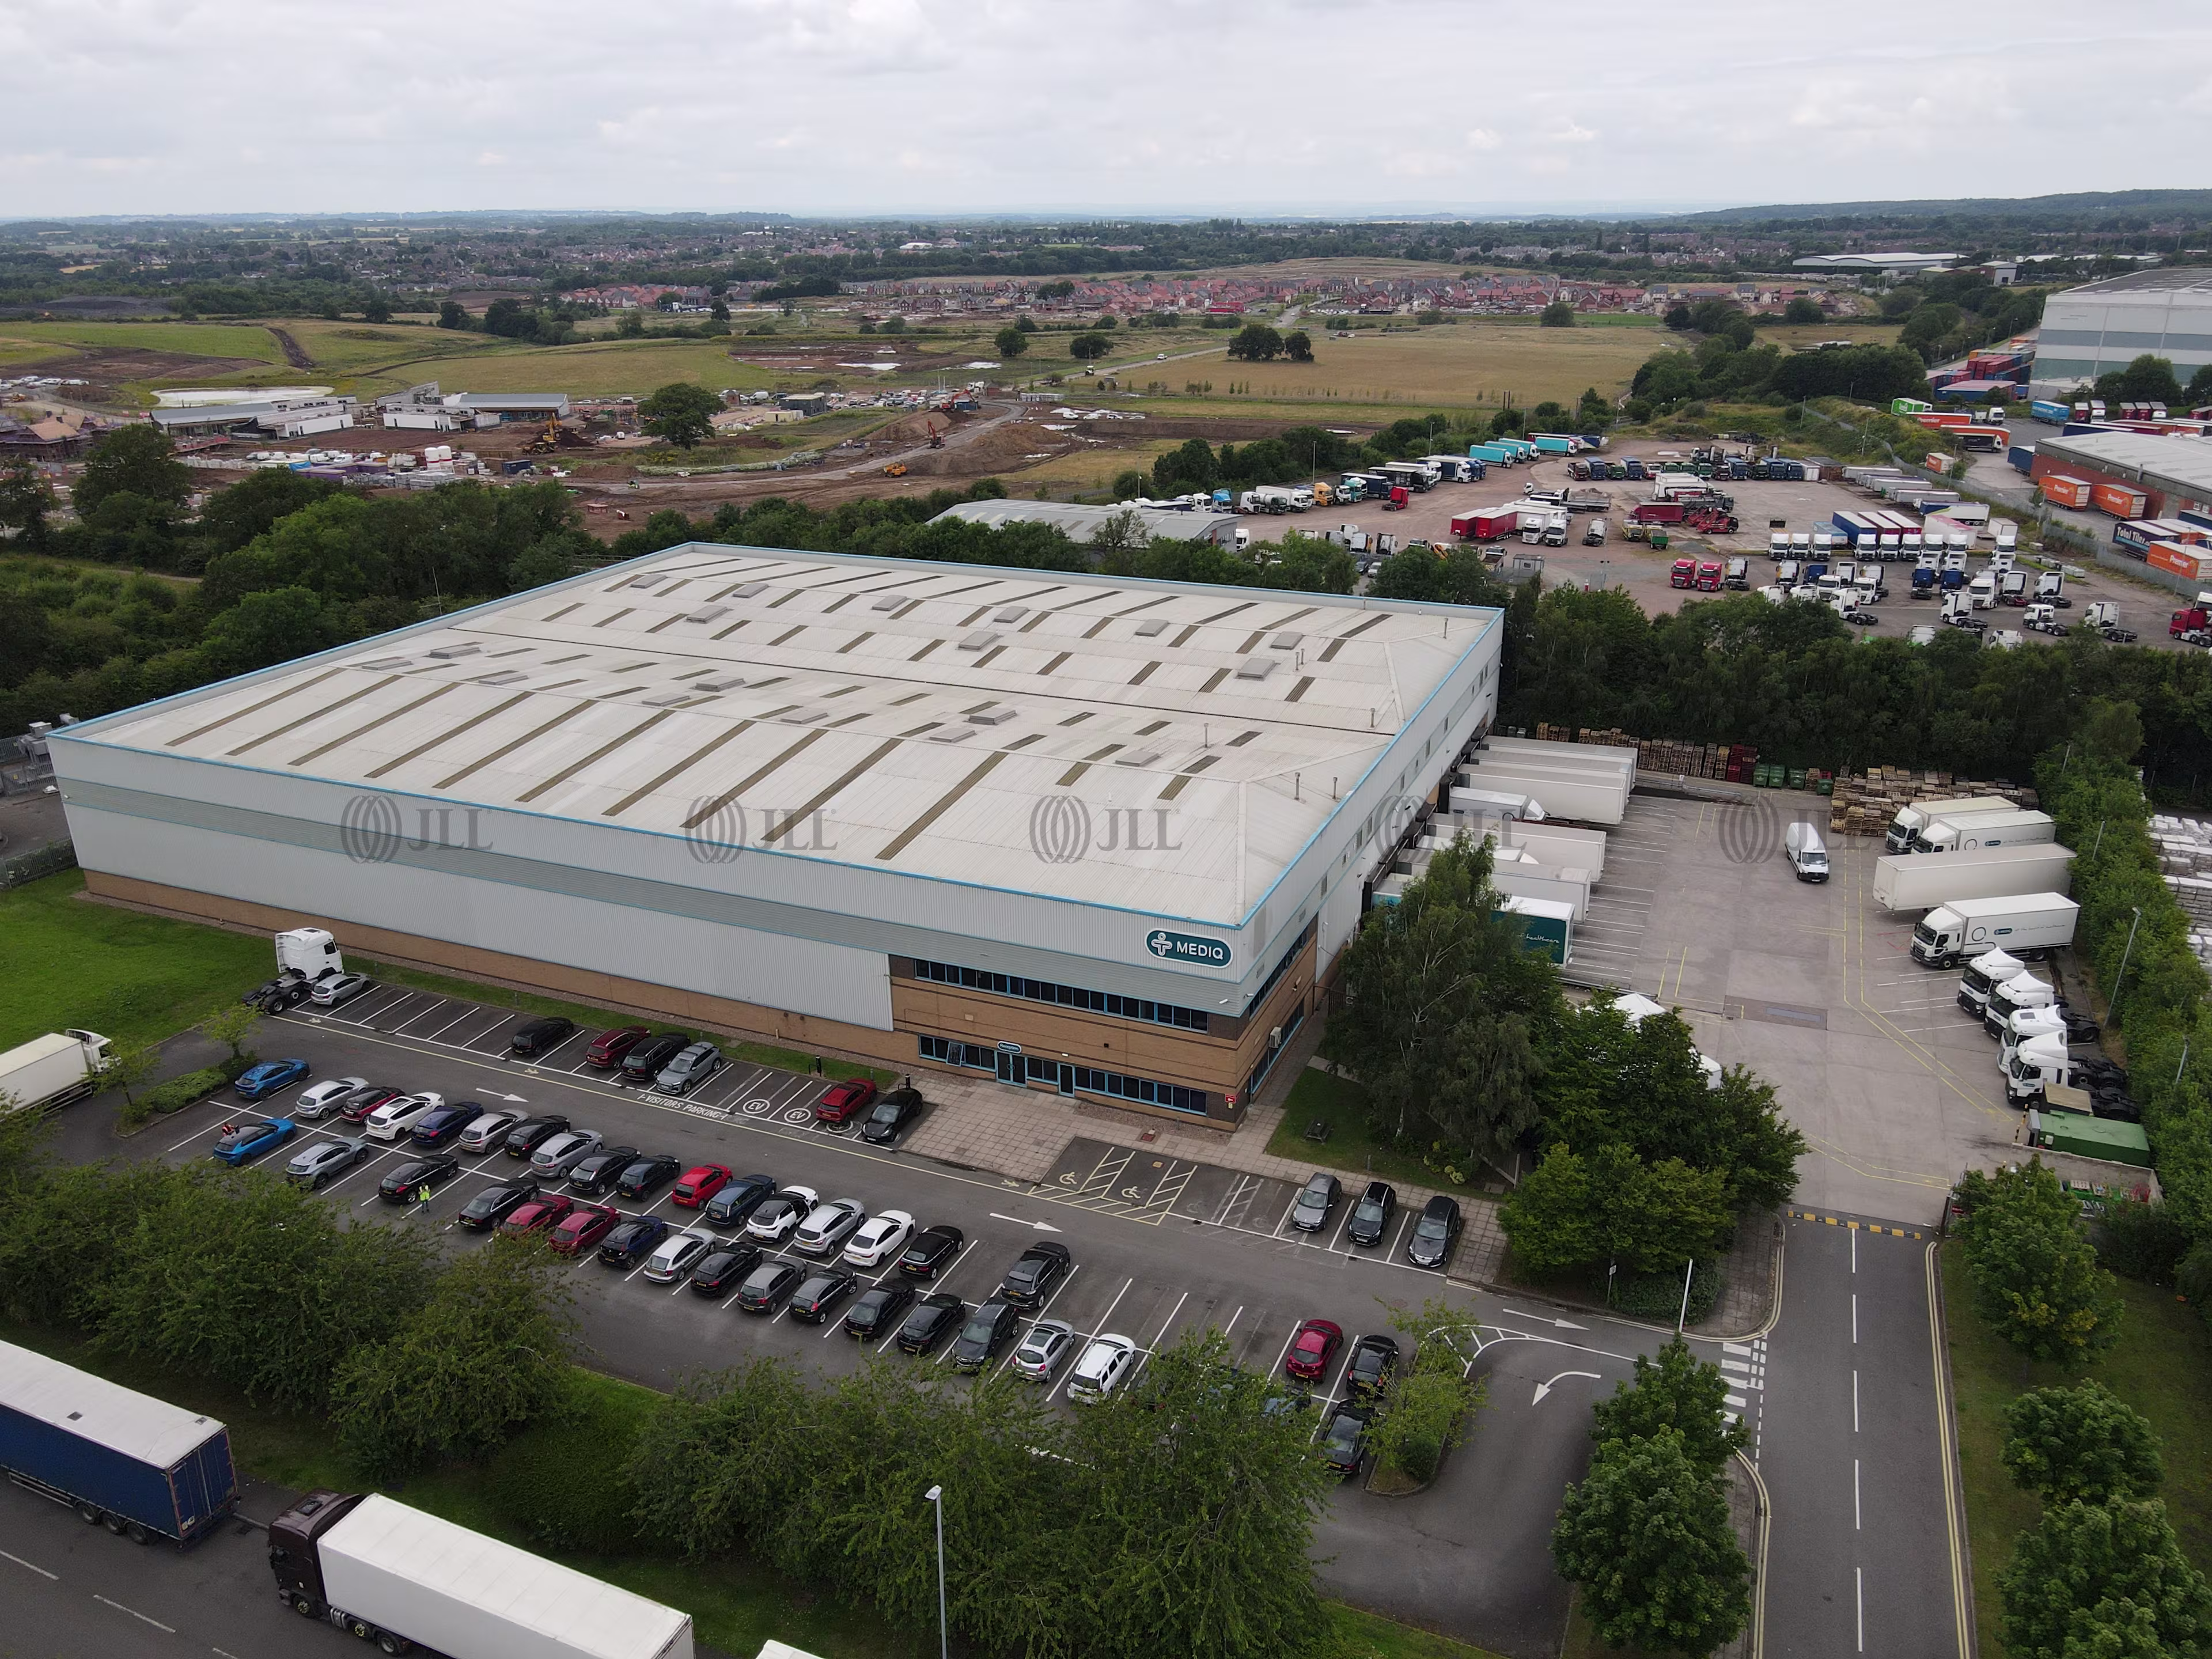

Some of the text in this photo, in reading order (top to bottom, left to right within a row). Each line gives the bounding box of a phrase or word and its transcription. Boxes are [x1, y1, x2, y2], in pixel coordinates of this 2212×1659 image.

[2118, 527, 2131, 539] Total
[1177, 941, 1223, 960] MEDIQ
[645, 1095, 721, 1118] VISITORS PARKING
[748, 1101, 765, 1111] EV
[789, 1111, 806, 1119] EV
